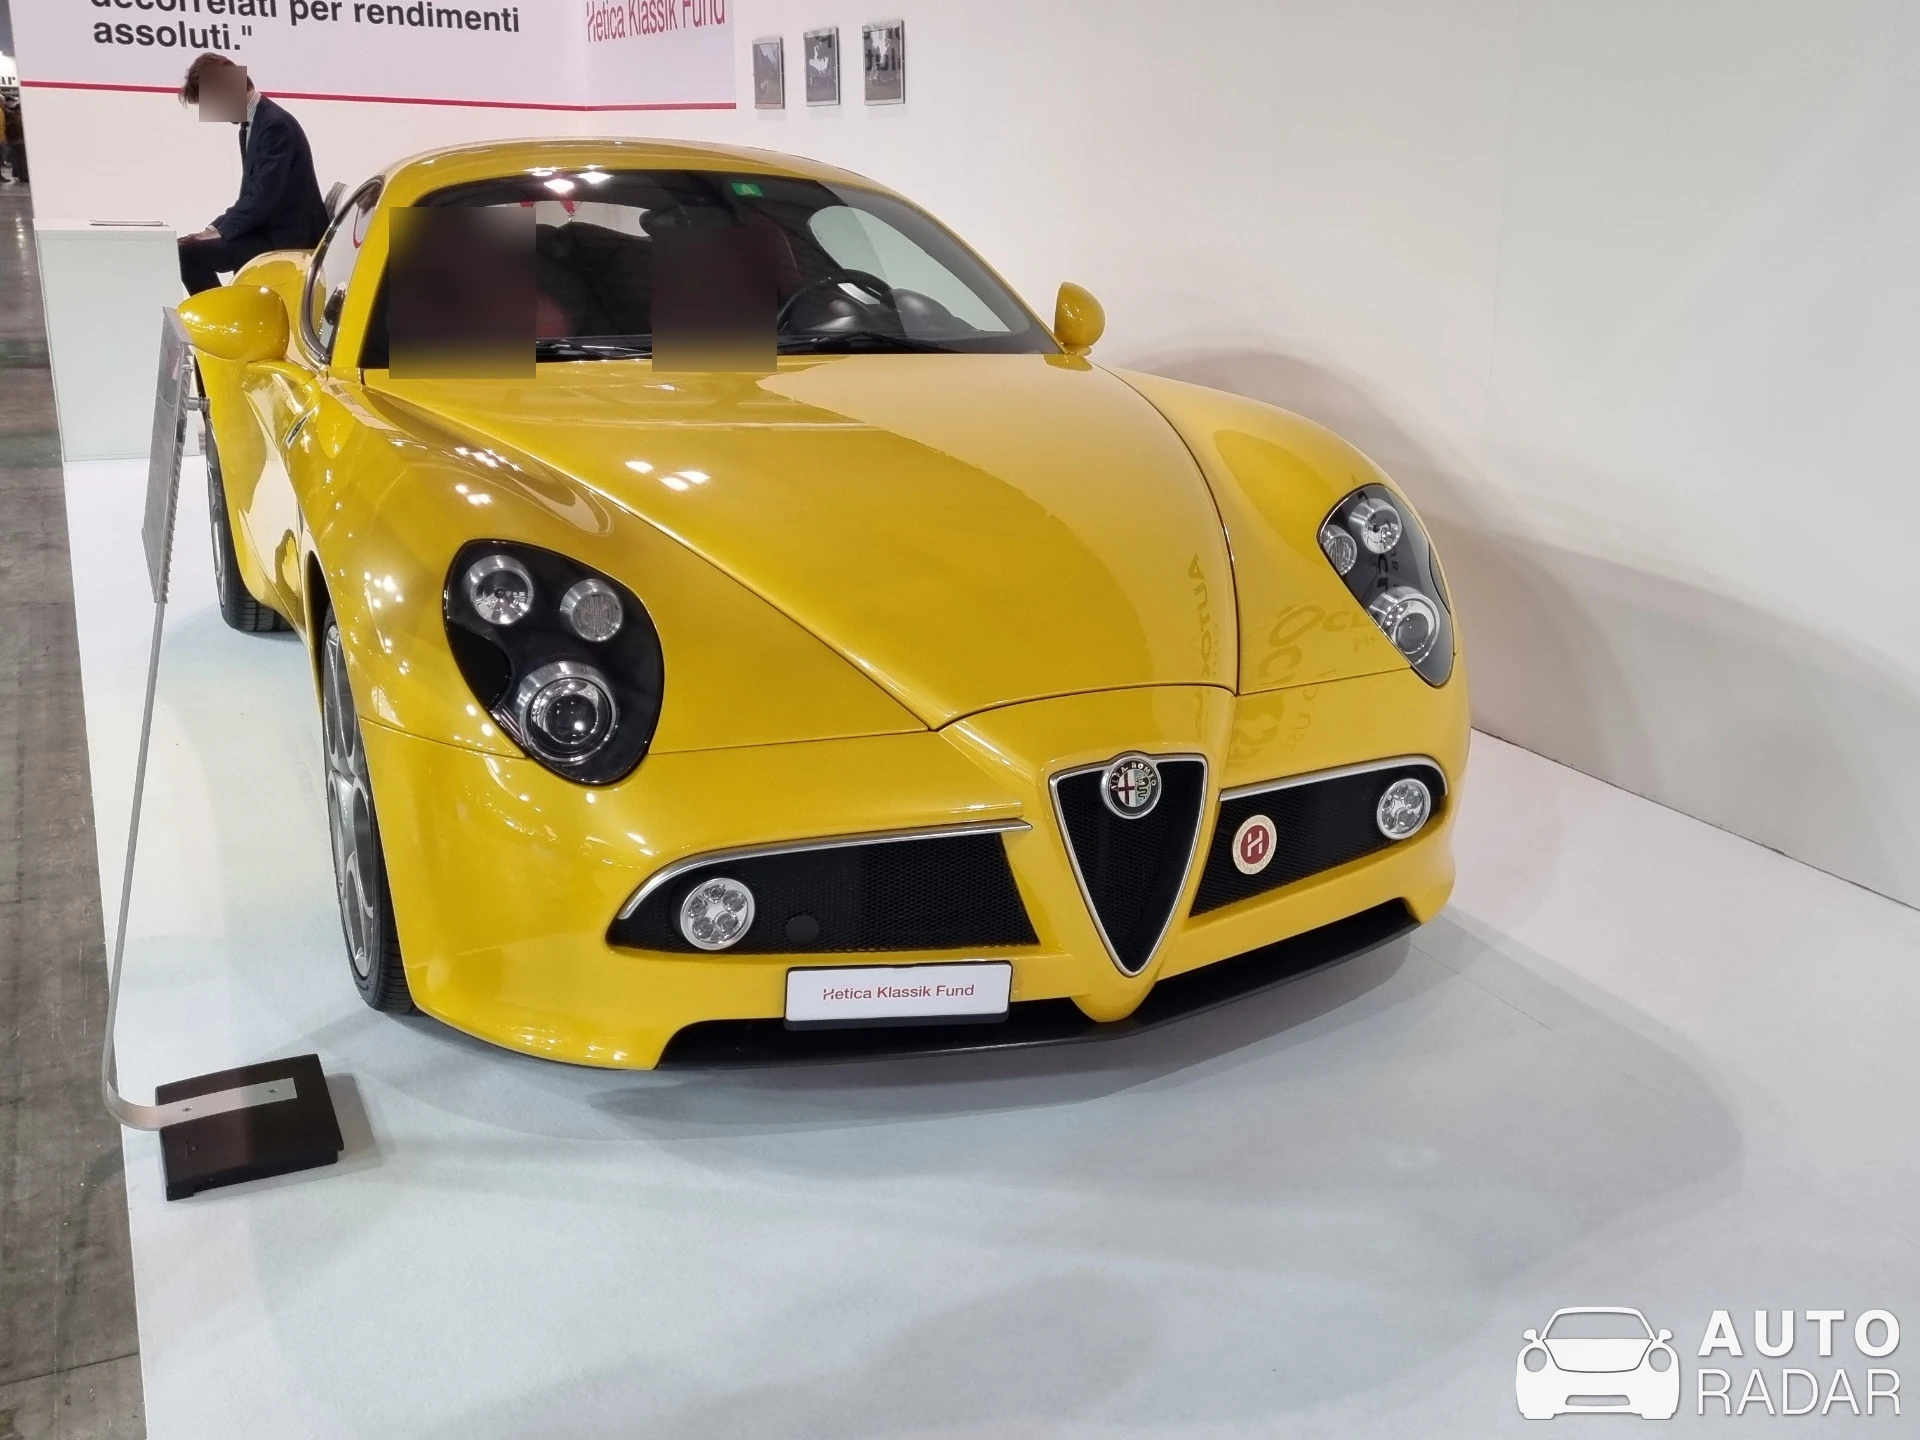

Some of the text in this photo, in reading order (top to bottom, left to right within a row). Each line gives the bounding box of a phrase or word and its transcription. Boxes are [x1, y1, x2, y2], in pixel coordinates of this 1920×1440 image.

[90, 0, 520, 33] orrelati per rendimenti
[586, 0, 726, 43] Hetica Klassik Fund
[93, 20, 253, 51] assoluti."
[1131, 762, 1157, 787] ROMEO
[822, 984, 975, 1000] Hetica Klassik Fund
